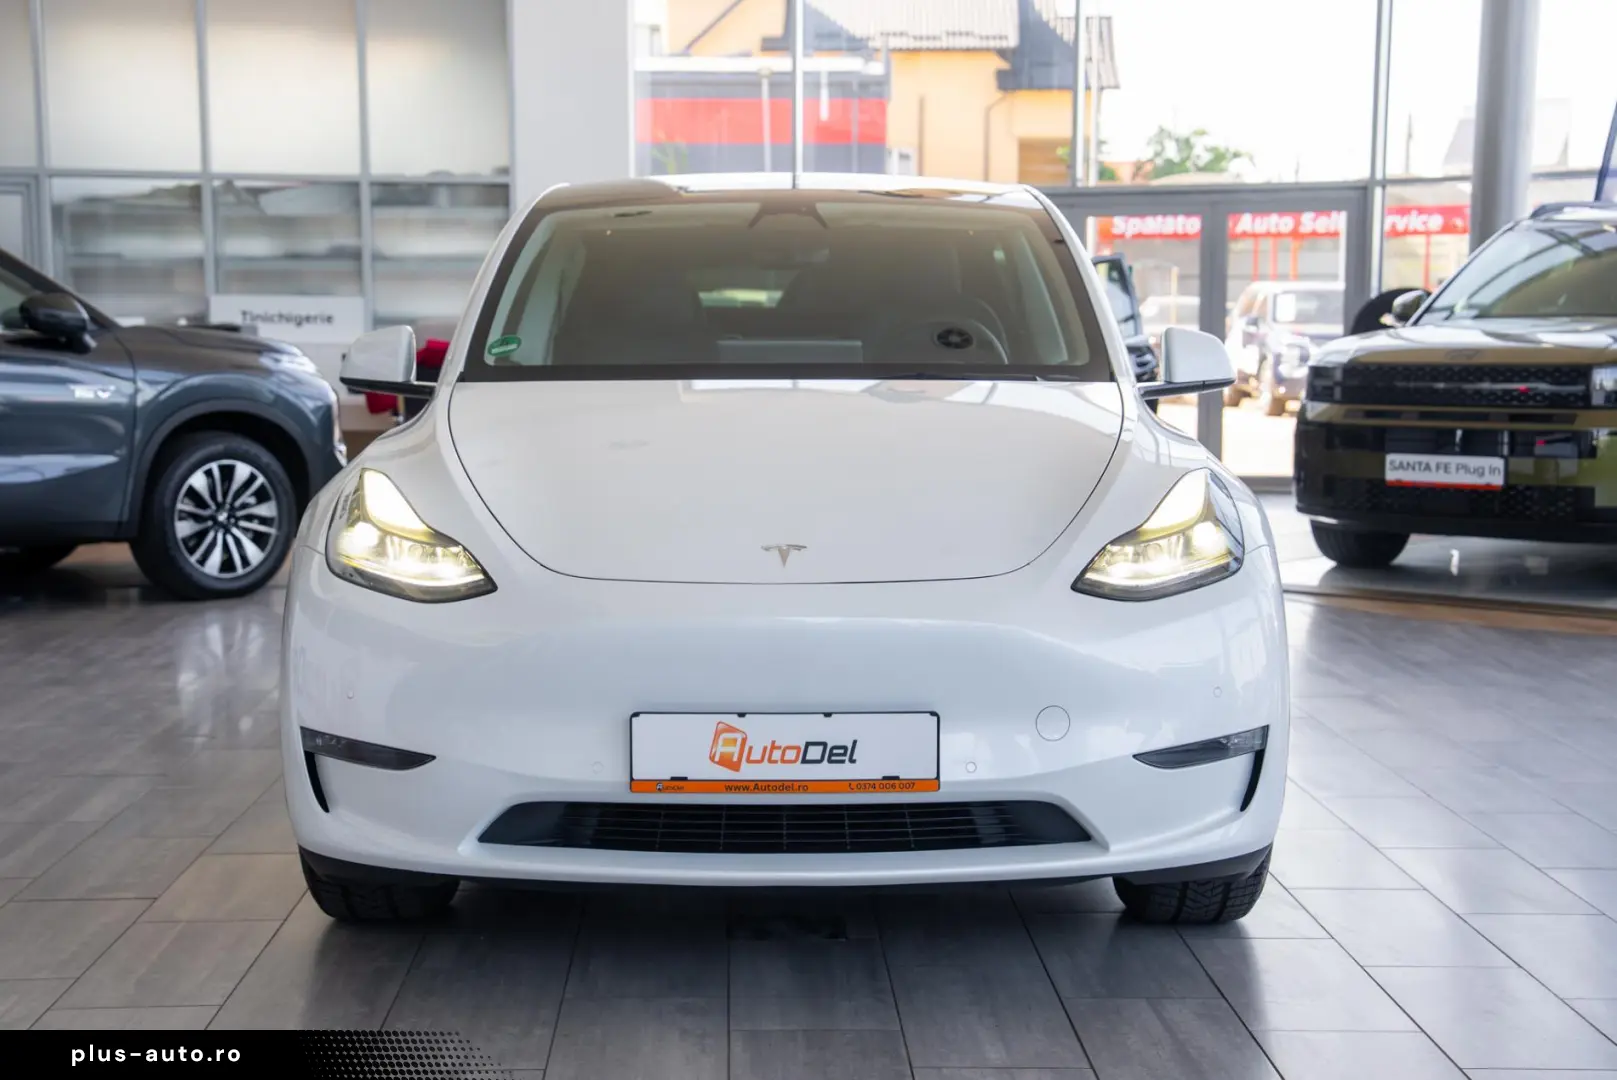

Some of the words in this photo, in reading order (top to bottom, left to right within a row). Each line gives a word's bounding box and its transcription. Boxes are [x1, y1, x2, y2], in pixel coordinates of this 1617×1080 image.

[1235, 211, 1295, 234] Auto
[1388, 459, 1432, 473] SANTA
[1436, 462, 1452, 475] FE
[1456, 463, 1485, 479] Plug
[1489, 465, 1501, 476] In
[711, 725, 858, 769] AutoDel
[724, 783, 809, 792] www.Autodel.ro
[856, 782, 876, 790] 0374
[879, 782, 896, 790] 006
[899, 782, 915, 790] 007
